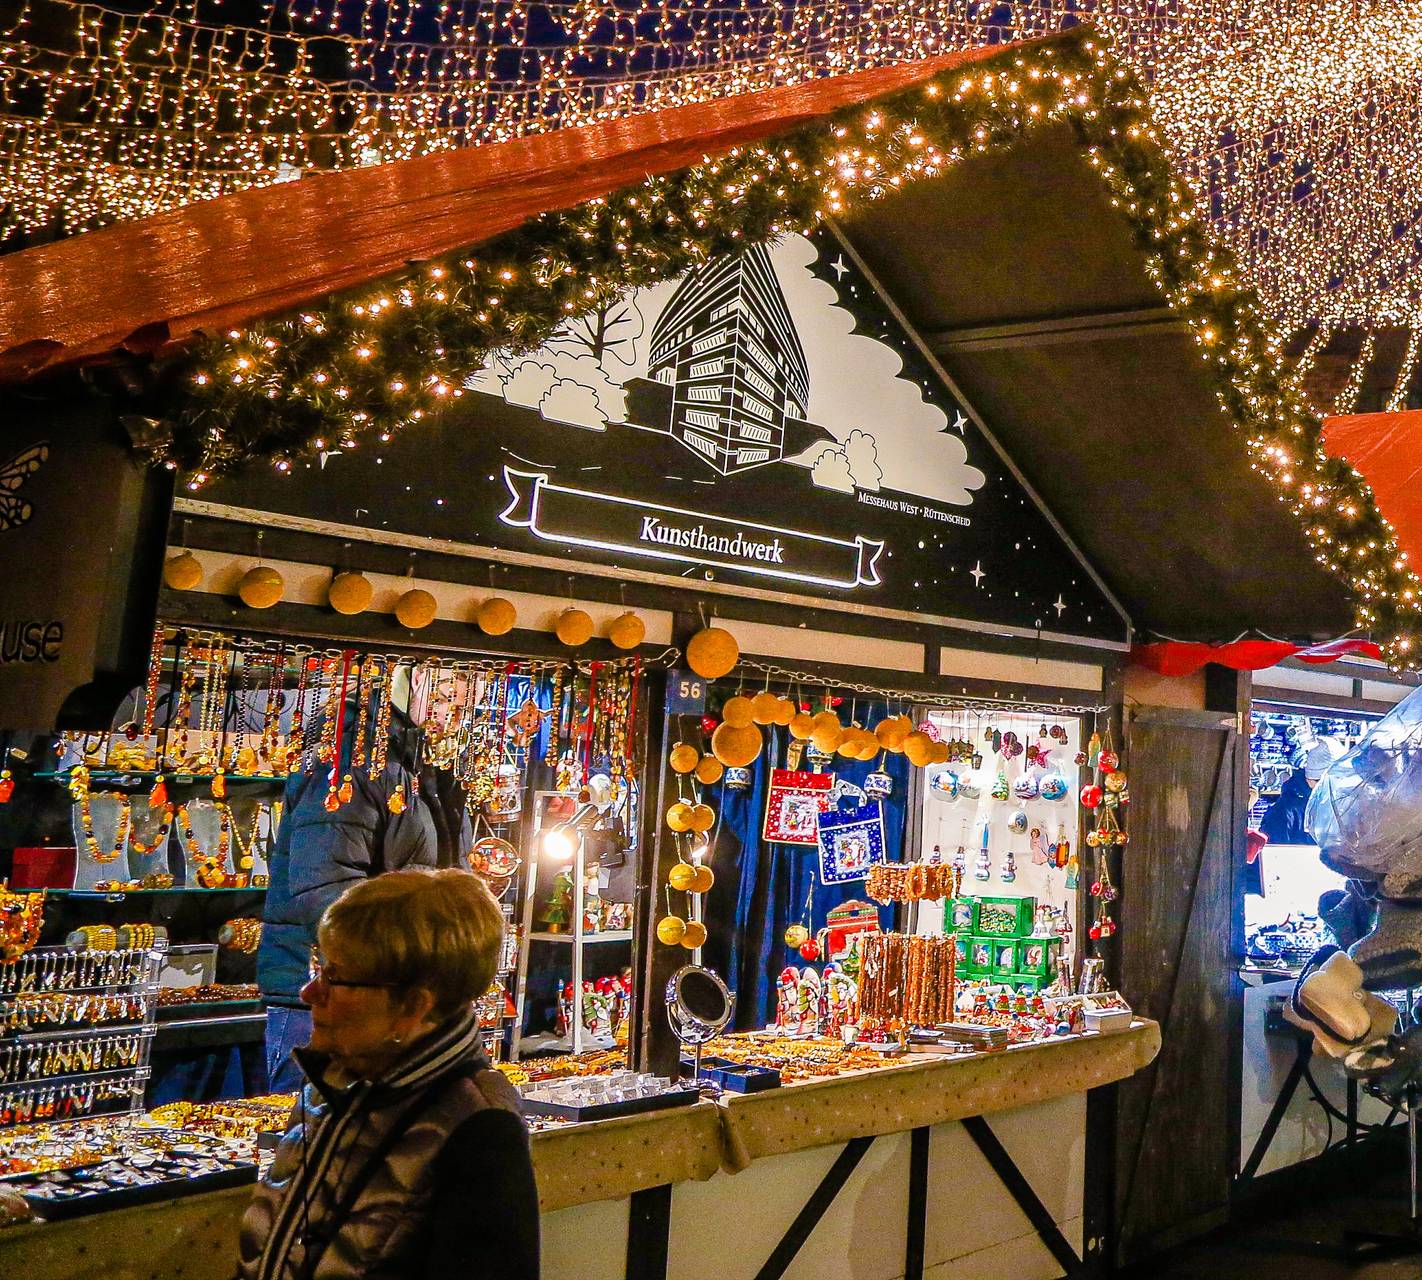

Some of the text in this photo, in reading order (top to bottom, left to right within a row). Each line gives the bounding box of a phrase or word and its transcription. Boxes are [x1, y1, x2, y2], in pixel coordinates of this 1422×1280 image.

[858, 491, 899, 511] MESSEHAUS
[900, 501, 919, 515] WEST
[640, 516, 784, 564] Kunsthandwerk
[680, 681, 701, 699] 56
